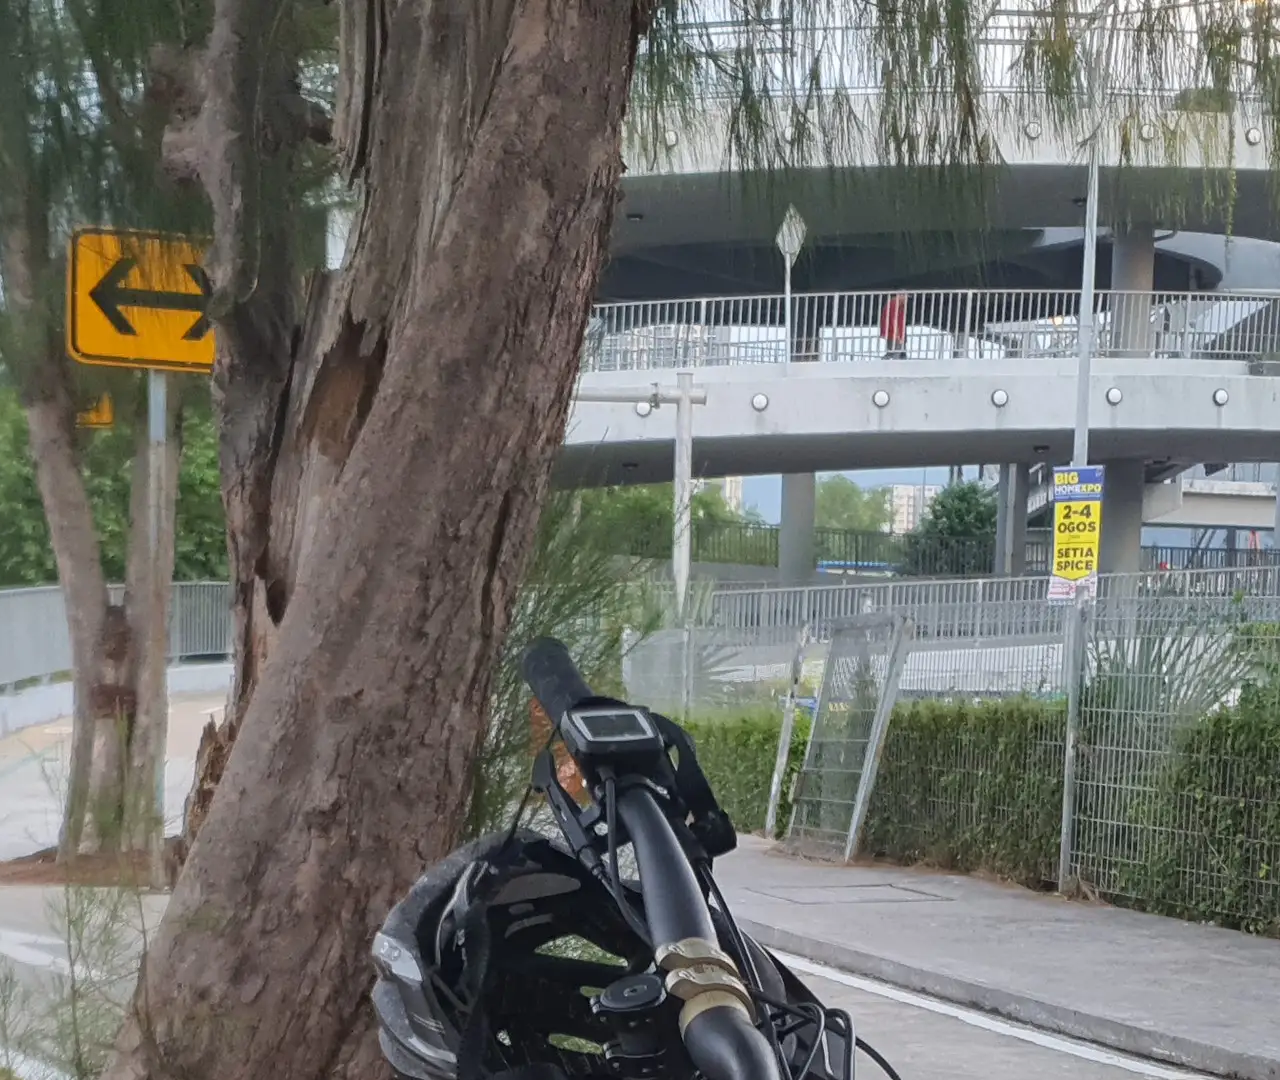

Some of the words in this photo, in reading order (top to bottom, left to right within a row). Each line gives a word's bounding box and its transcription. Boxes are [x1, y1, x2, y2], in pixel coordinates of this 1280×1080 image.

[1054, 471, 1079, 485] BIG
[1062, 504, 1092, 519] 2-4
[1057, 521, 1096, 533] OGOS
[1057, 547, 1094, 559] SETIA
[1056, 560, 1093, 572] SPICE
